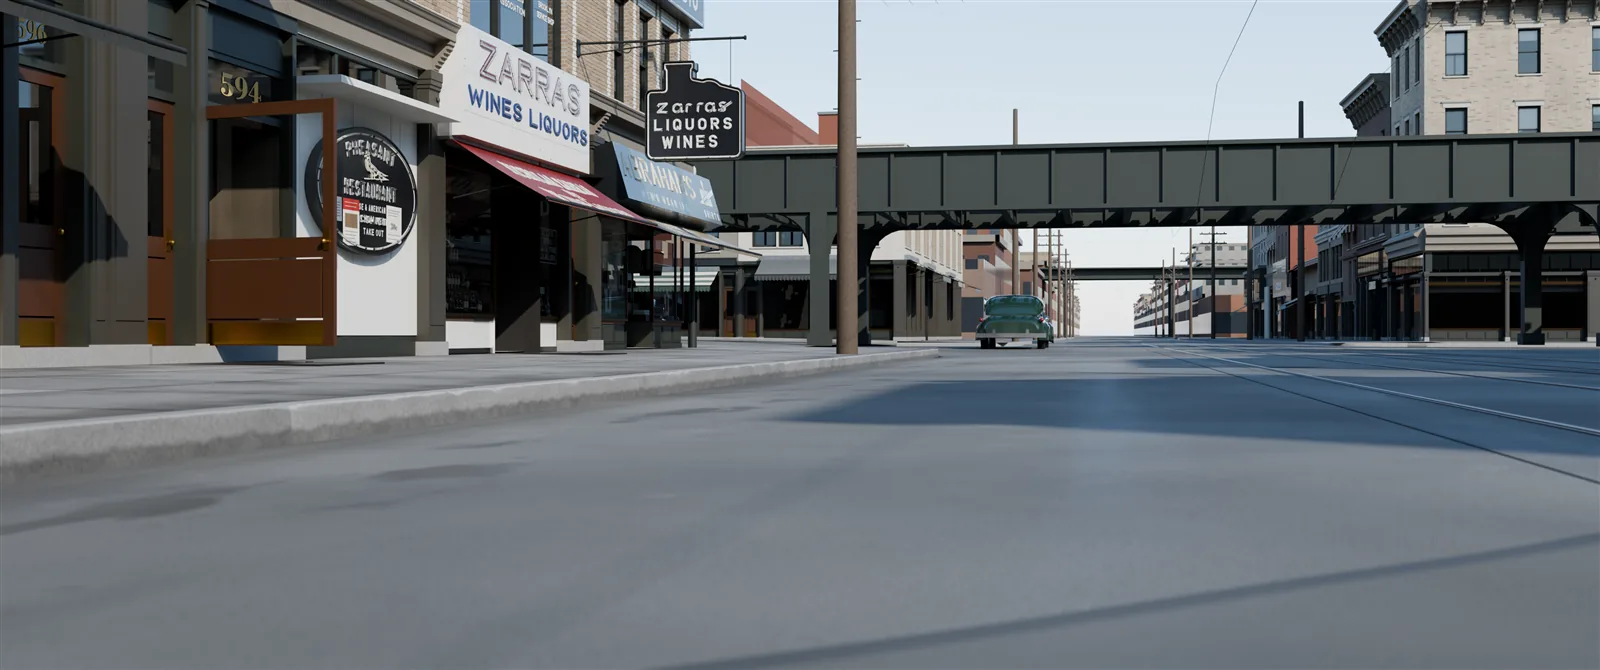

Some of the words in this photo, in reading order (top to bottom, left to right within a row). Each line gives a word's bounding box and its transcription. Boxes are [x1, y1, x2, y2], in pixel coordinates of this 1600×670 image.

[220, 72, 262, 104] 594
[479, 39, 580, 117] ZARRAS
[467, 83, 523, 123] WINES
[528, 108, 588, 147] LIQUORS
[653, 117, 733, 132] LIQUORS
[345, 139, 396, 167] PHEASANT
[661, 134, 719, 150] WINES
[343, 177, 397, 203] RESTAURANT
[363, 227, 375, 237] TAKE
[375, 229, 384, 238] OUT
